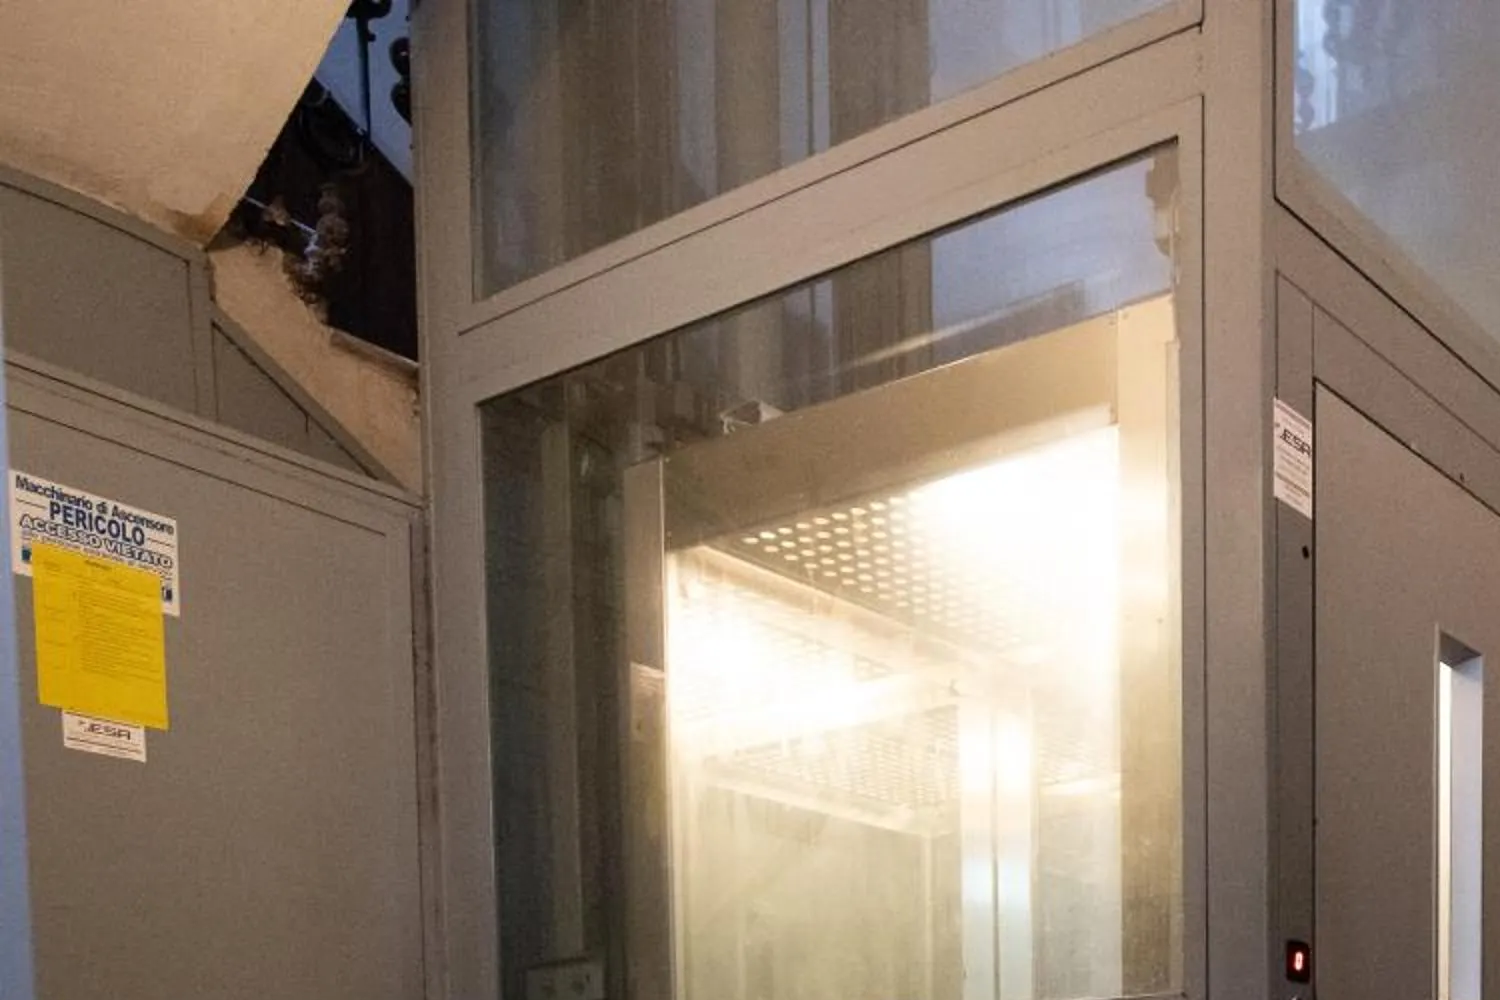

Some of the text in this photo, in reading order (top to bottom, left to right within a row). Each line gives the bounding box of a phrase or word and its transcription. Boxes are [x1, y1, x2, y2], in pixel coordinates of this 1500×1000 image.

[15, 474, 93, 511] Macchinario
[95, 501, 108, 515] di
[19, 513, 103, 549] ACCESSO
[103, 538, 174, 569] VIETATO
[48, 500, 145, 547] PERICOLO
